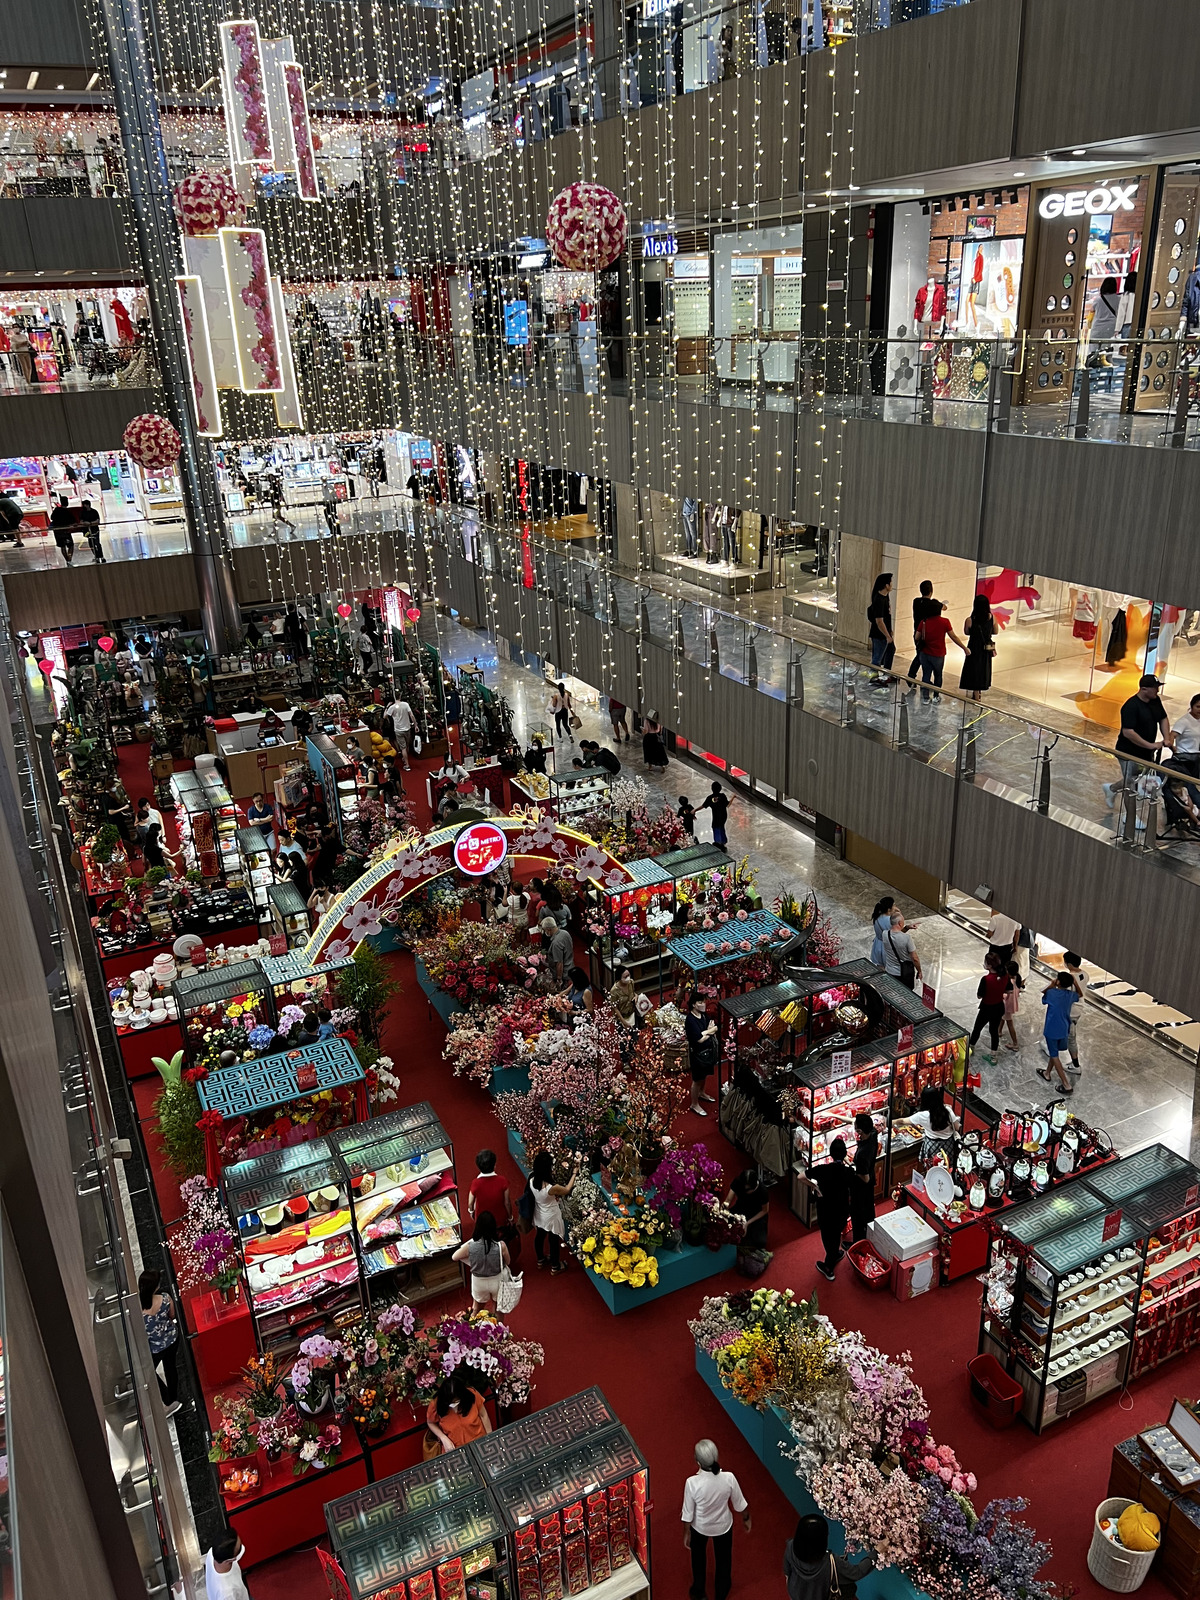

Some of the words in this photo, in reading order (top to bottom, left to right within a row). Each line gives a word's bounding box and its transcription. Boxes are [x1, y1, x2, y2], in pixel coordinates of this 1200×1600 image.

[643, 235, 678, 257] Alexis
[1041, 316, 1075, 325] RESPIRA
[481, 836, 502, 845] METRO
[271, 942, 285, 951] 20%
[191, 952, 205, 960] 20%
[298, 1074, 315, 1084] 20%
[1104, 1222, 1118, 1233] 20%
